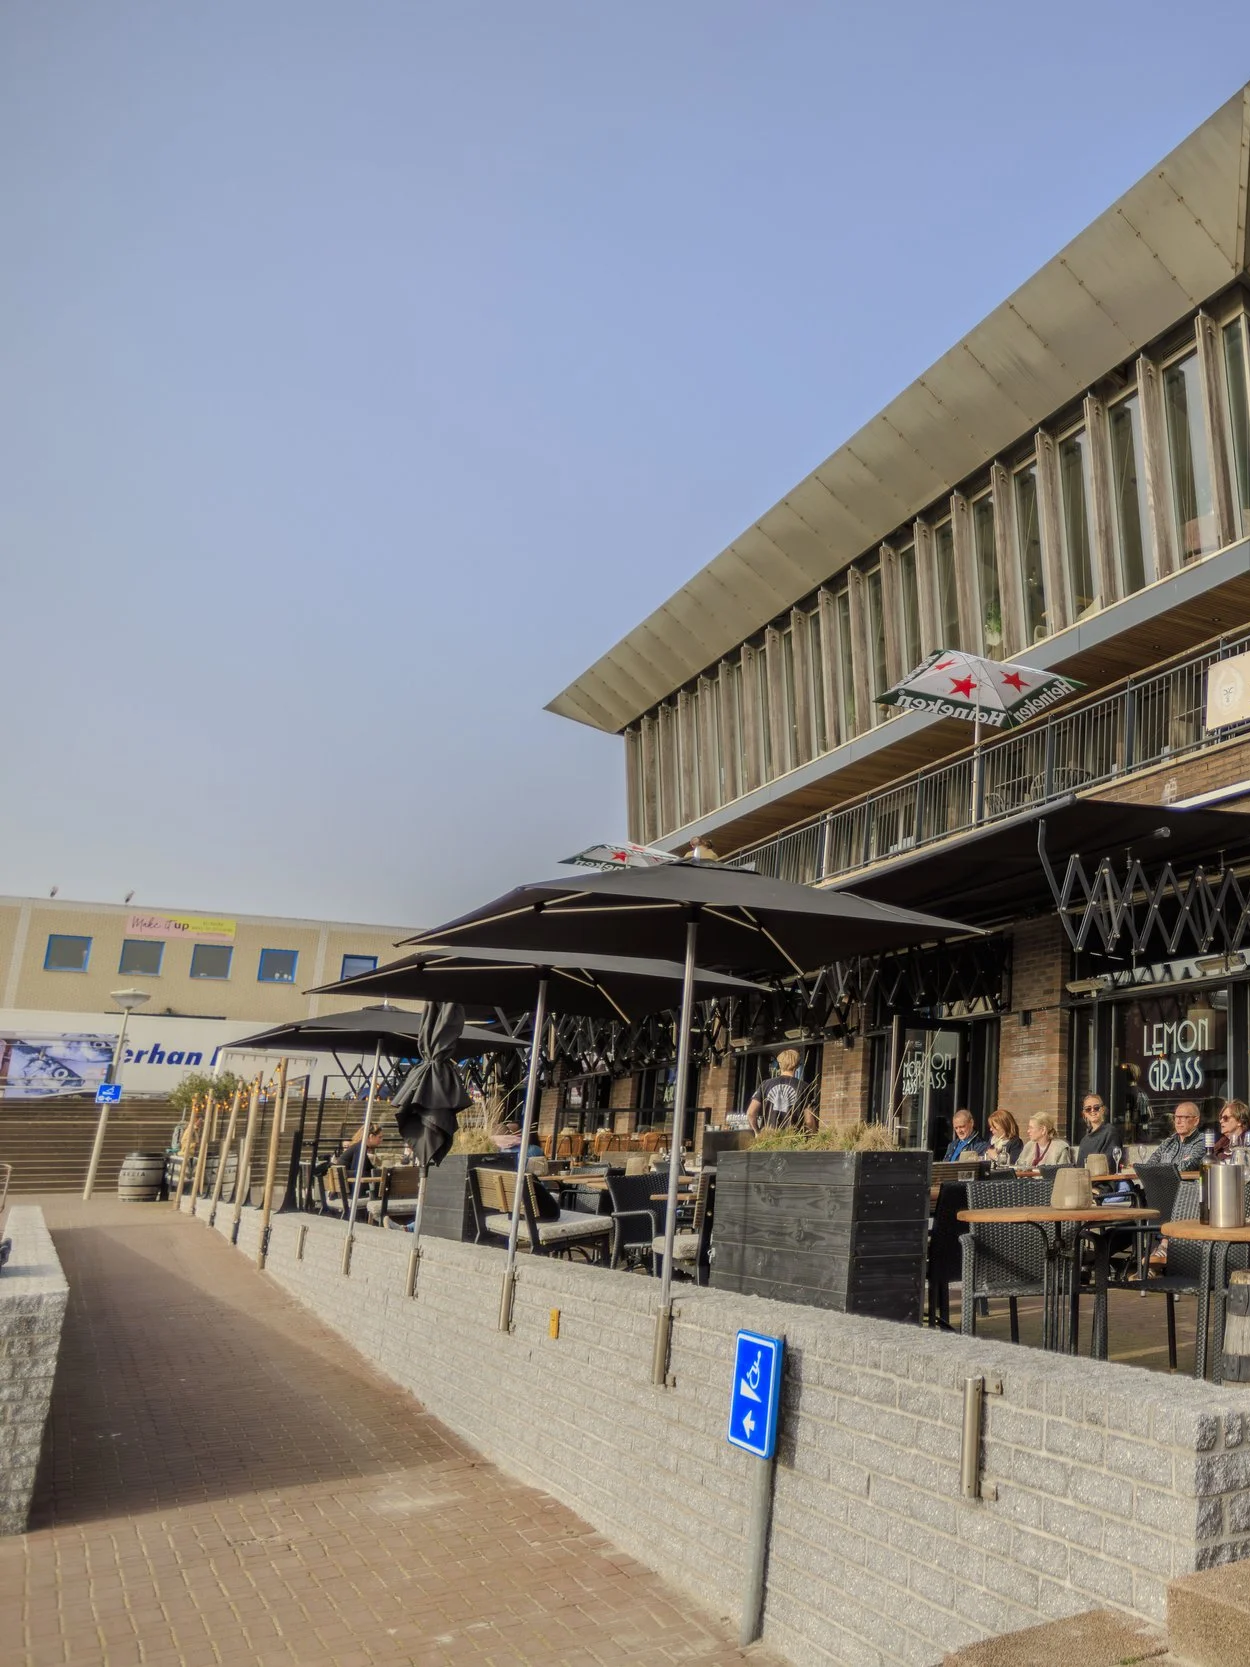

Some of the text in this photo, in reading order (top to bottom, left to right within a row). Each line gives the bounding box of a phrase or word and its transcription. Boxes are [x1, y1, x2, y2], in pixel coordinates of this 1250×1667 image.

[174, 922, 189, 931] up
[1143, 1018, 1208, 1056] LEMON
[1148, 1056, 1203, 1091] GRASS
